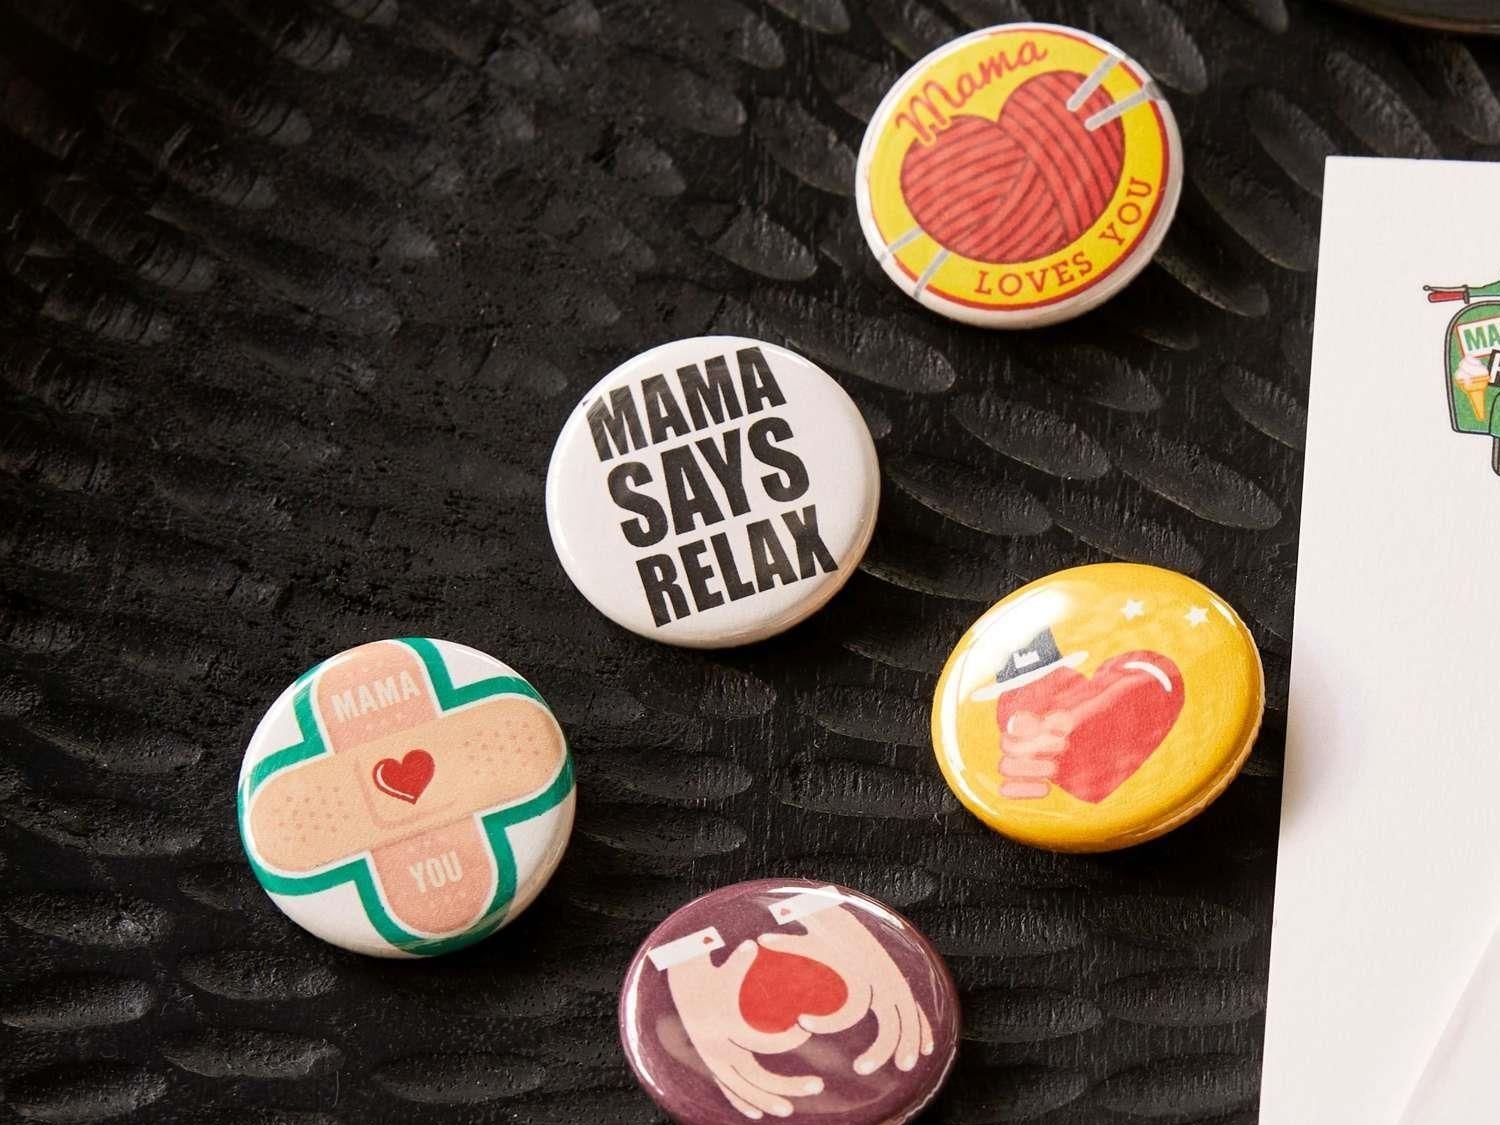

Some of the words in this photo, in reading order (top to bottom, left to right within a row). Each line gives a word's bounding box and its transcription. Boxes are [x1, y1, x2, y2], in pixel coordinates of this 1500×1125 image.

[895, 40, 1048, 147] Mama
[974, 251, 1094, 297] LOVES
[1100, 180, 1154, 247] YOU
[582, 346, 788, 462] MAMA
[607, 416, 810, 548] SAYS
[635, 504, 839, 628] RELAX
[330, 670, 421, 723] MAMA
[409, 851, 464, 893] YOU
